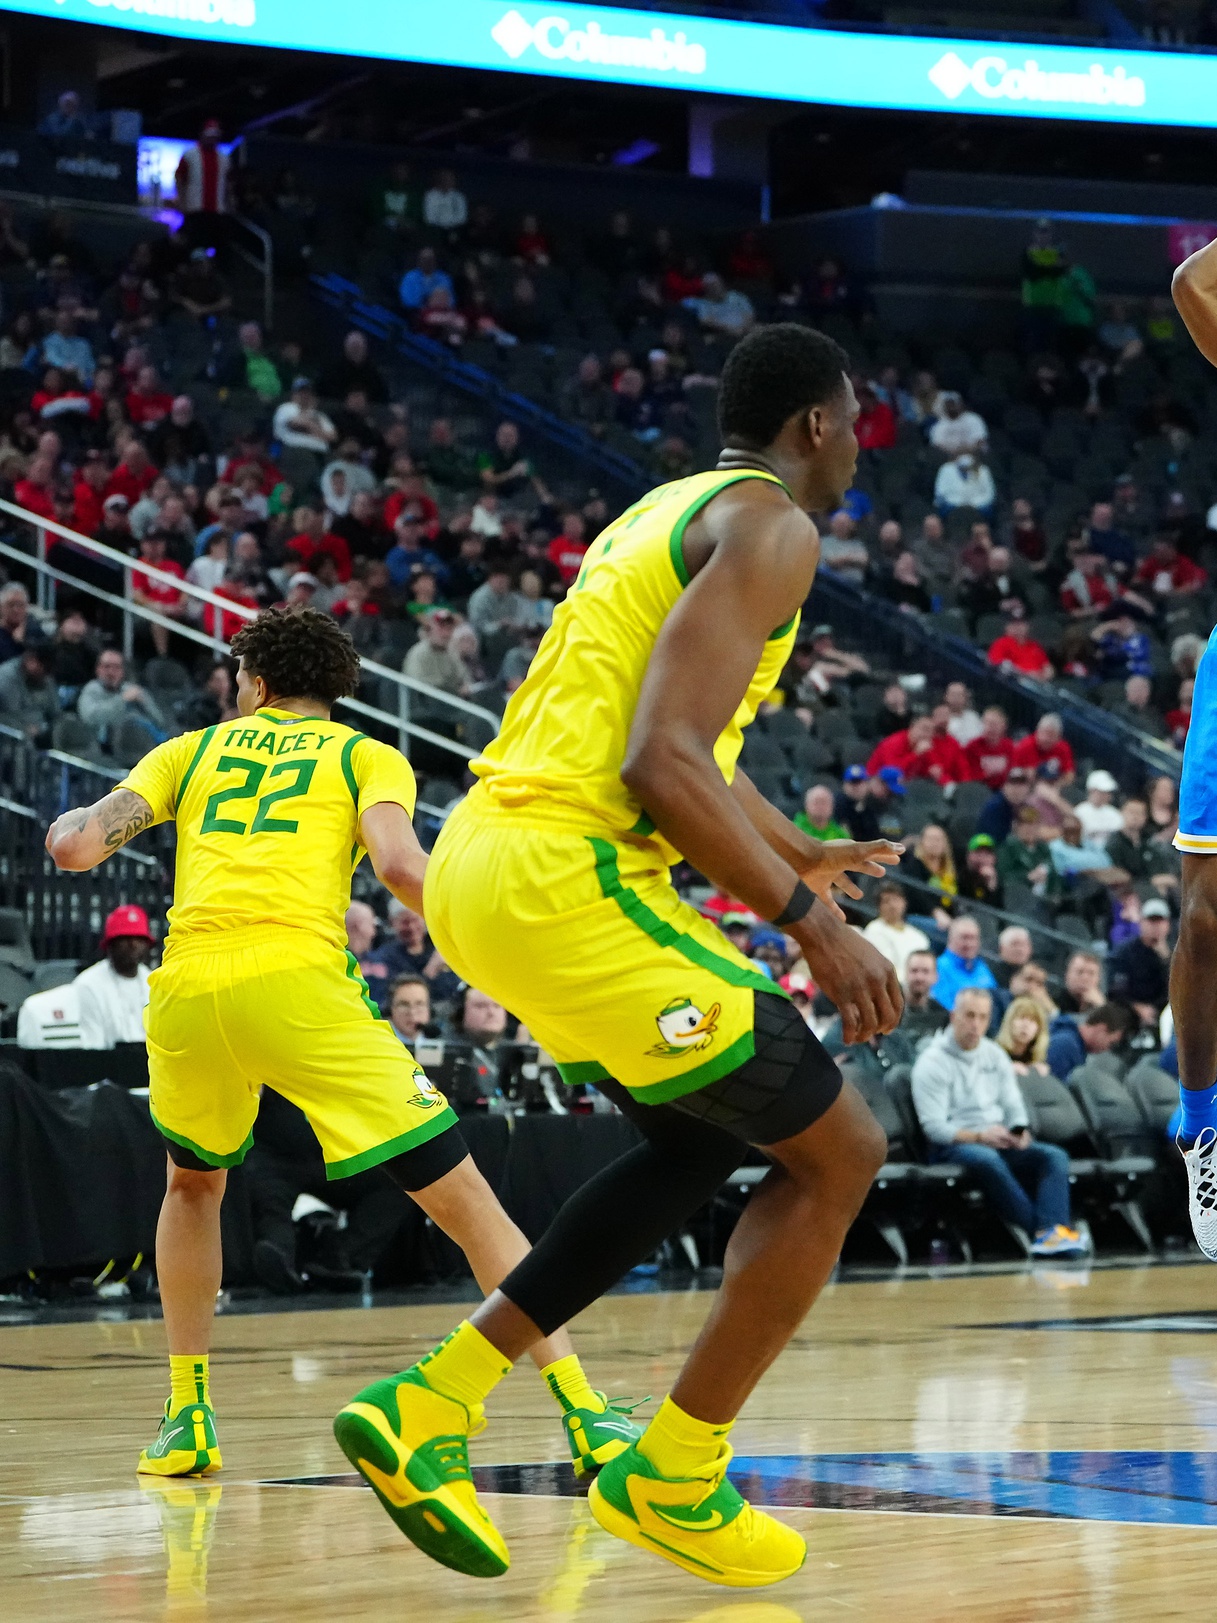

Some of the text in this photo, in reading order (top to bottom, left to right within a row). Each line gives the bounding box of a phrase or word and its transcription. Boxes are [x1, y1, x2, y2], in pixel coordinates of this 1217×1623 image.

[533, 15, 706, 74] Columbia
[971, 56, 1146, 107] Columbia
[223, 729, 336, 756] TRACEY
[199, 755, 319, 836] 22
